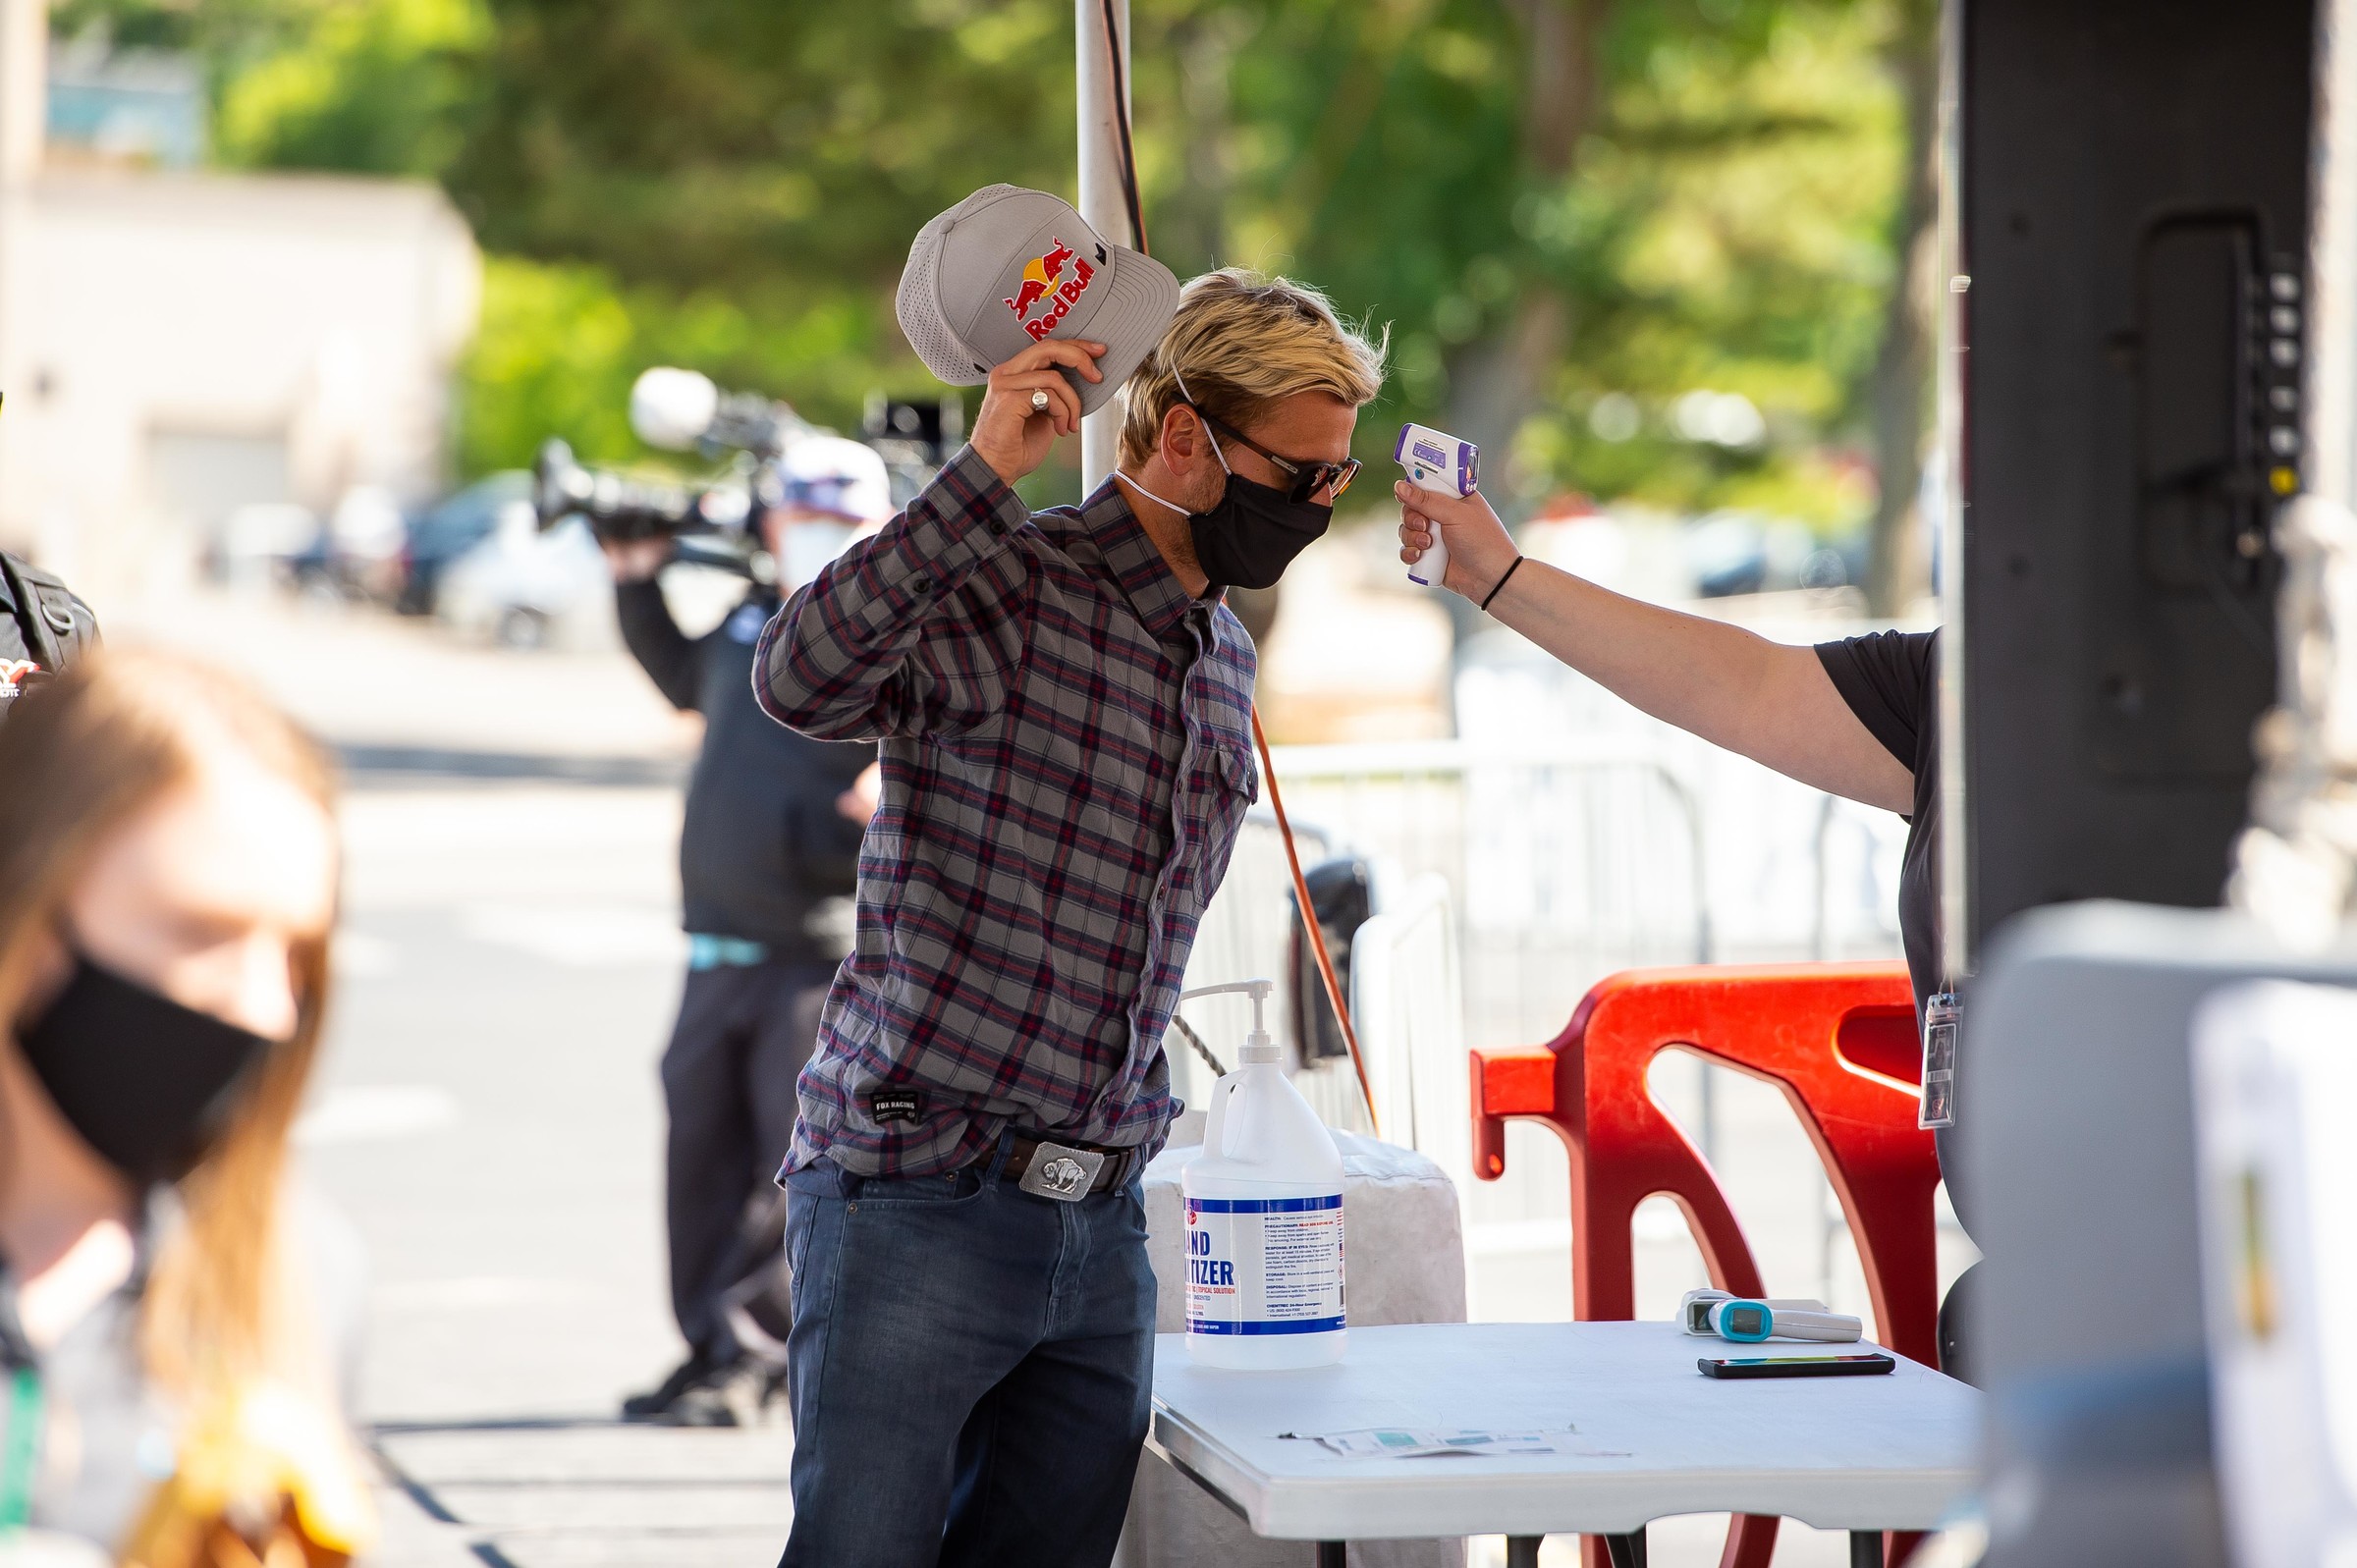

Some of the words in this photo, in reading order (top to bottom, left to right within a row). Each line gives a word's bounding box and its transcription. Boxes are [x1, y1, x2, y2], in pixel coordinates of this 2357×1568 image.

[1023, 293, 1071, 343] Red
[1058, 255, 1096, 306] Bull
[876, 1102, 890, 1110] FOX
